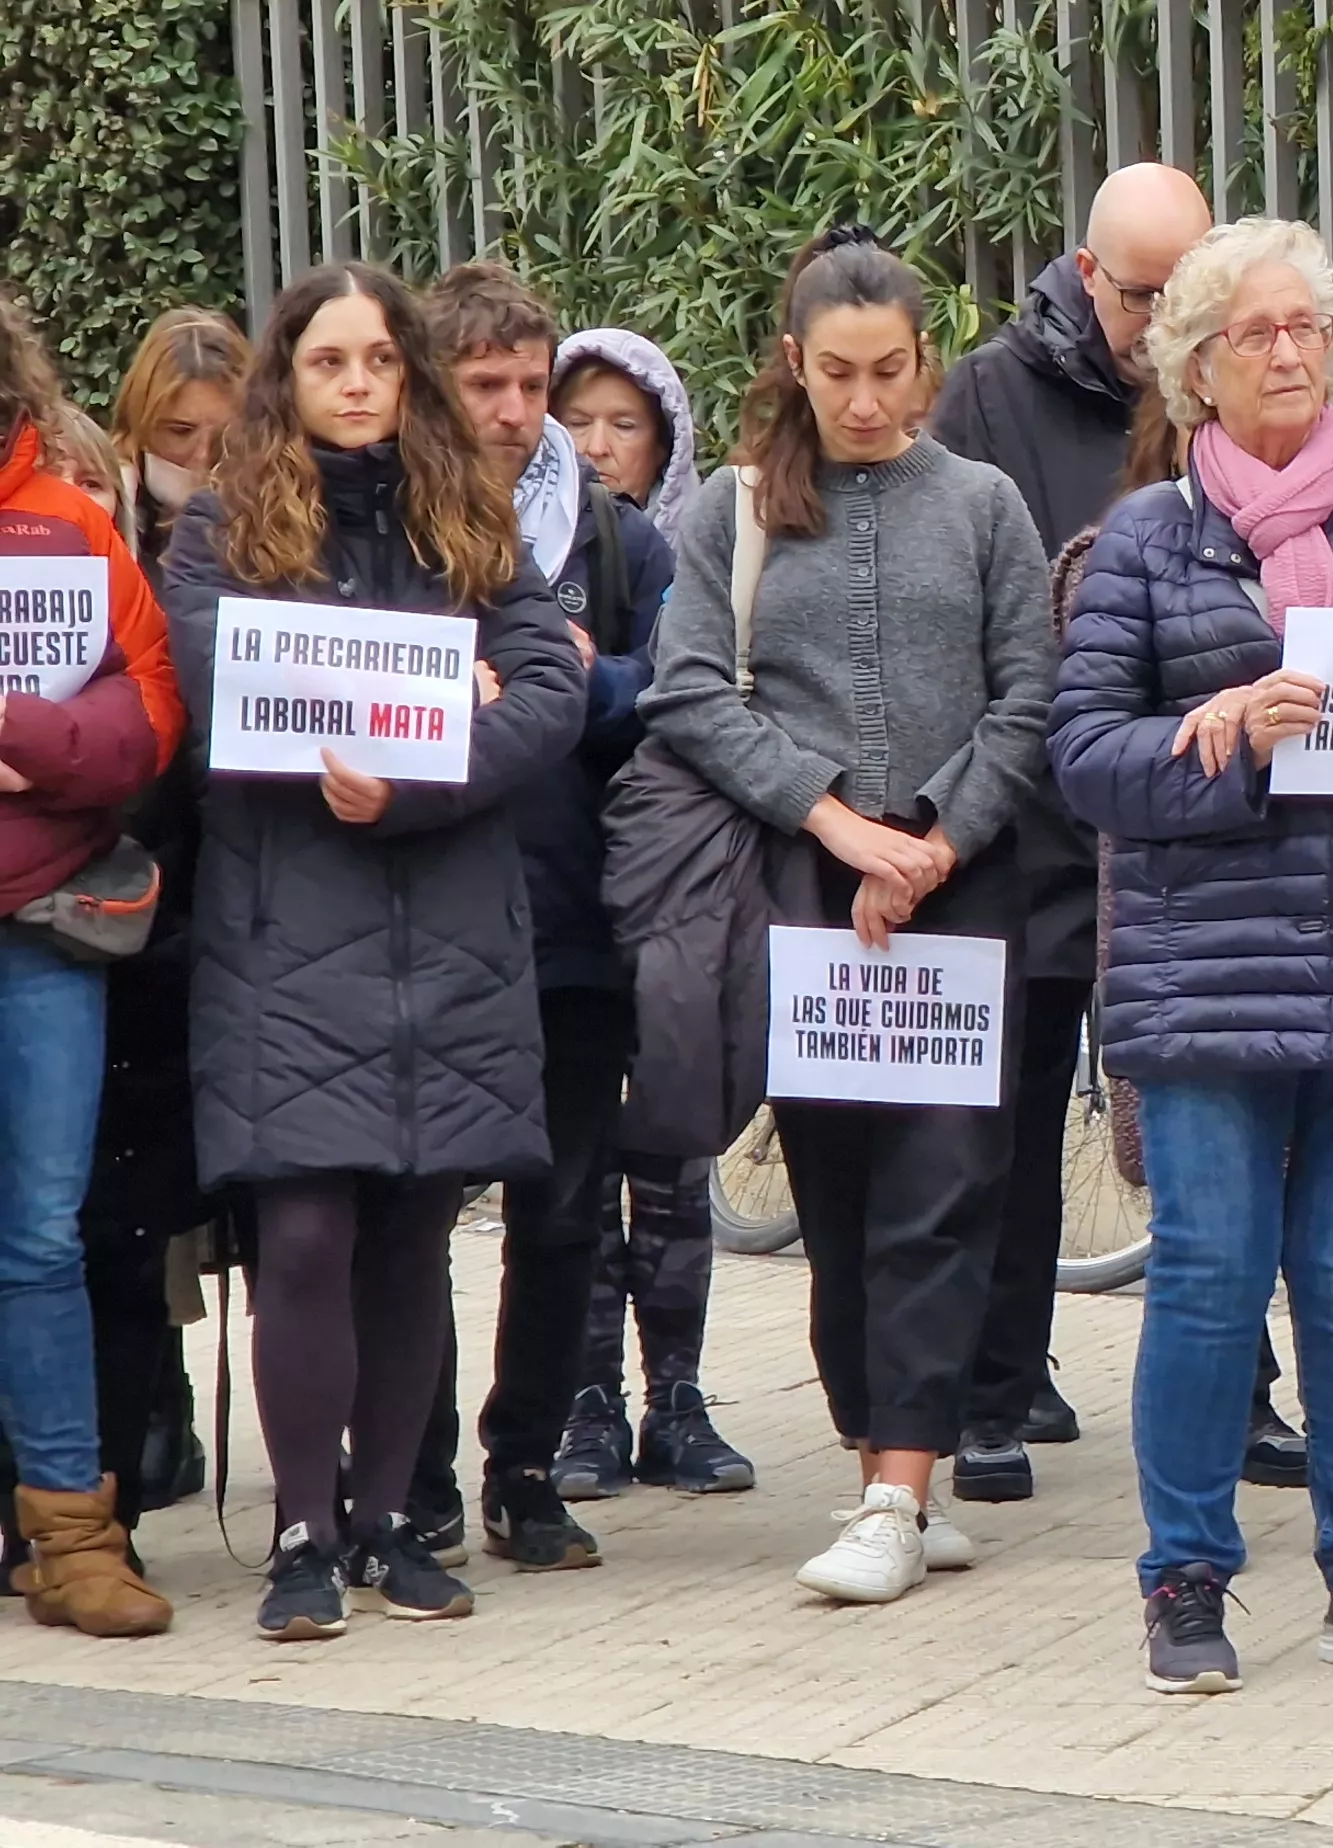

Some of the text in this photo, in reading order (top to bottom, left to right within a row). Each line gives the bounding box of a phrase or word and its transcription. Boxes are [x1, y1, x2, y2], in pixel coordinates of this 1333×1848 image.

[0, 589, 93, 629] RABAJO
[0, 631, 89, 666] CUESTE
[231, 627, 460, 680] LA PRECARIEDAD
[240, 695, 445, 741] LABORAL MATA
[828, 962, 944, 996] LA VIDA DE
[792, 995, 990, 1032] LAS QUE CUIDAMOS
[795, 1028, 983, 1067] TAMBIÉN IMPORTA
